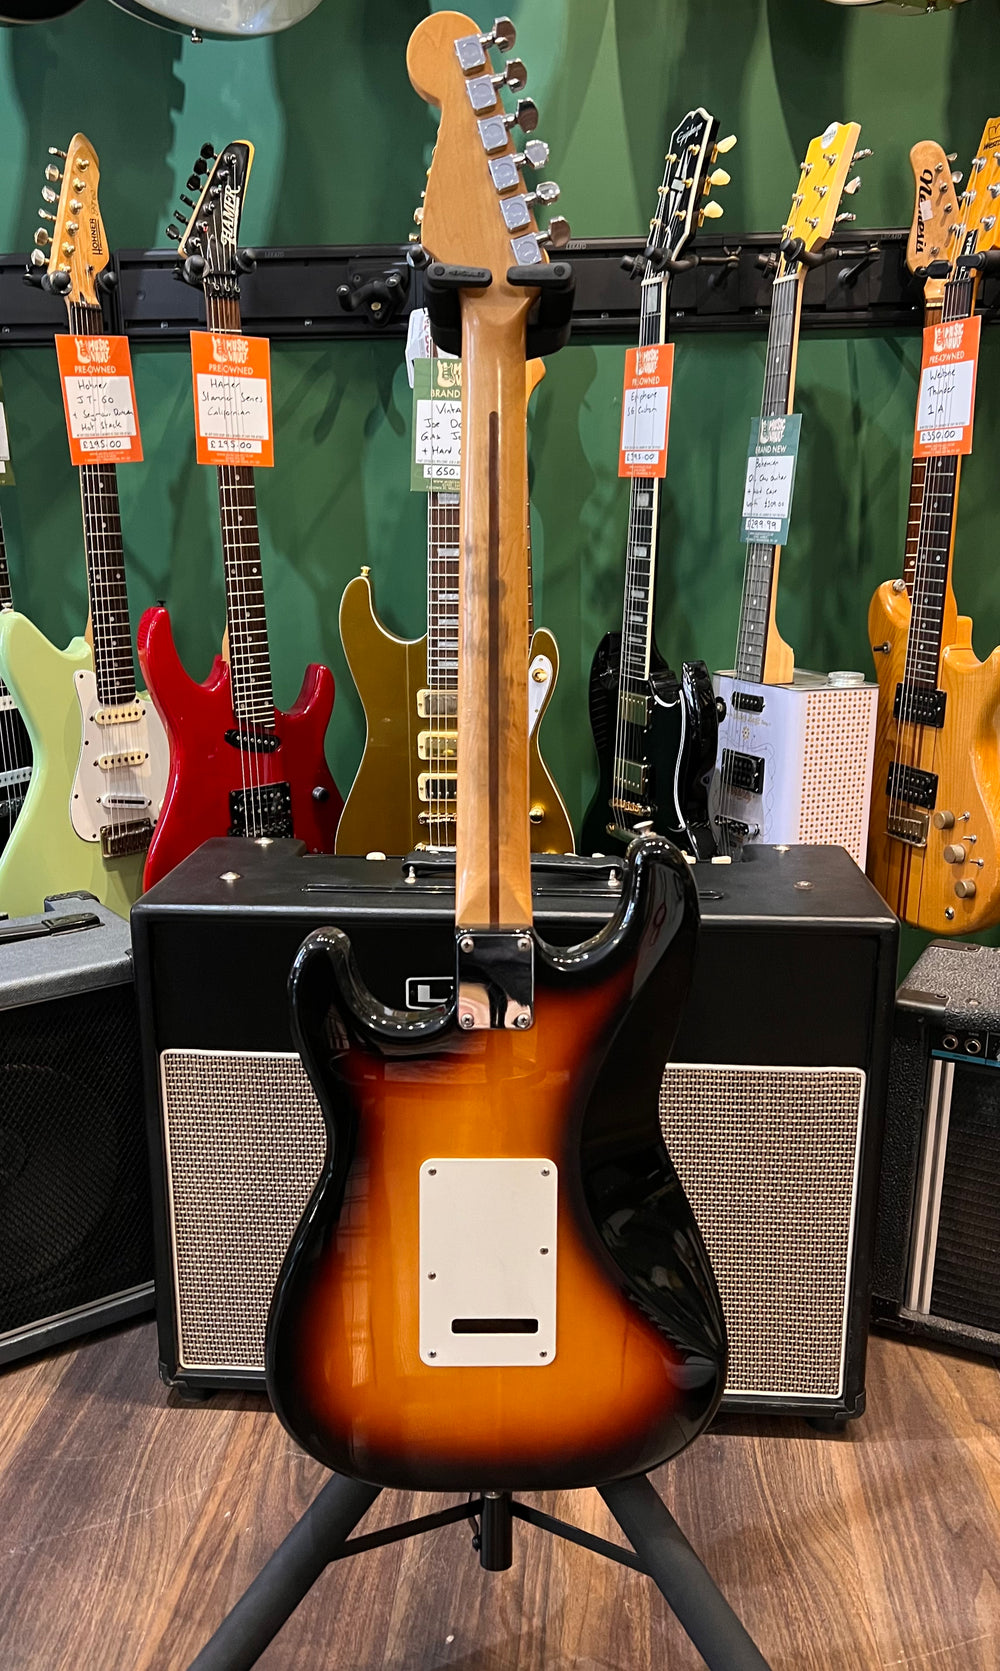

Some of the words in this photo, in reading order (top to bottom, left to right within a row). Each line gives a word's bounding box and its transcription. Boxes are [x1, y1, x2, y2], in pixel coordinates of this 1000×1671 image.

[221, 184, 241, 246] HAMER
[916, 169, 933, 254] Neesis
[90, 218, 103, 256] HOHNER
[226, 338, 249, 353] MUSIC
[430, 389, 461, 398] BRAND
[436, 402, 462, 415] Vinta
[772, 445, 788, 454] NEW
